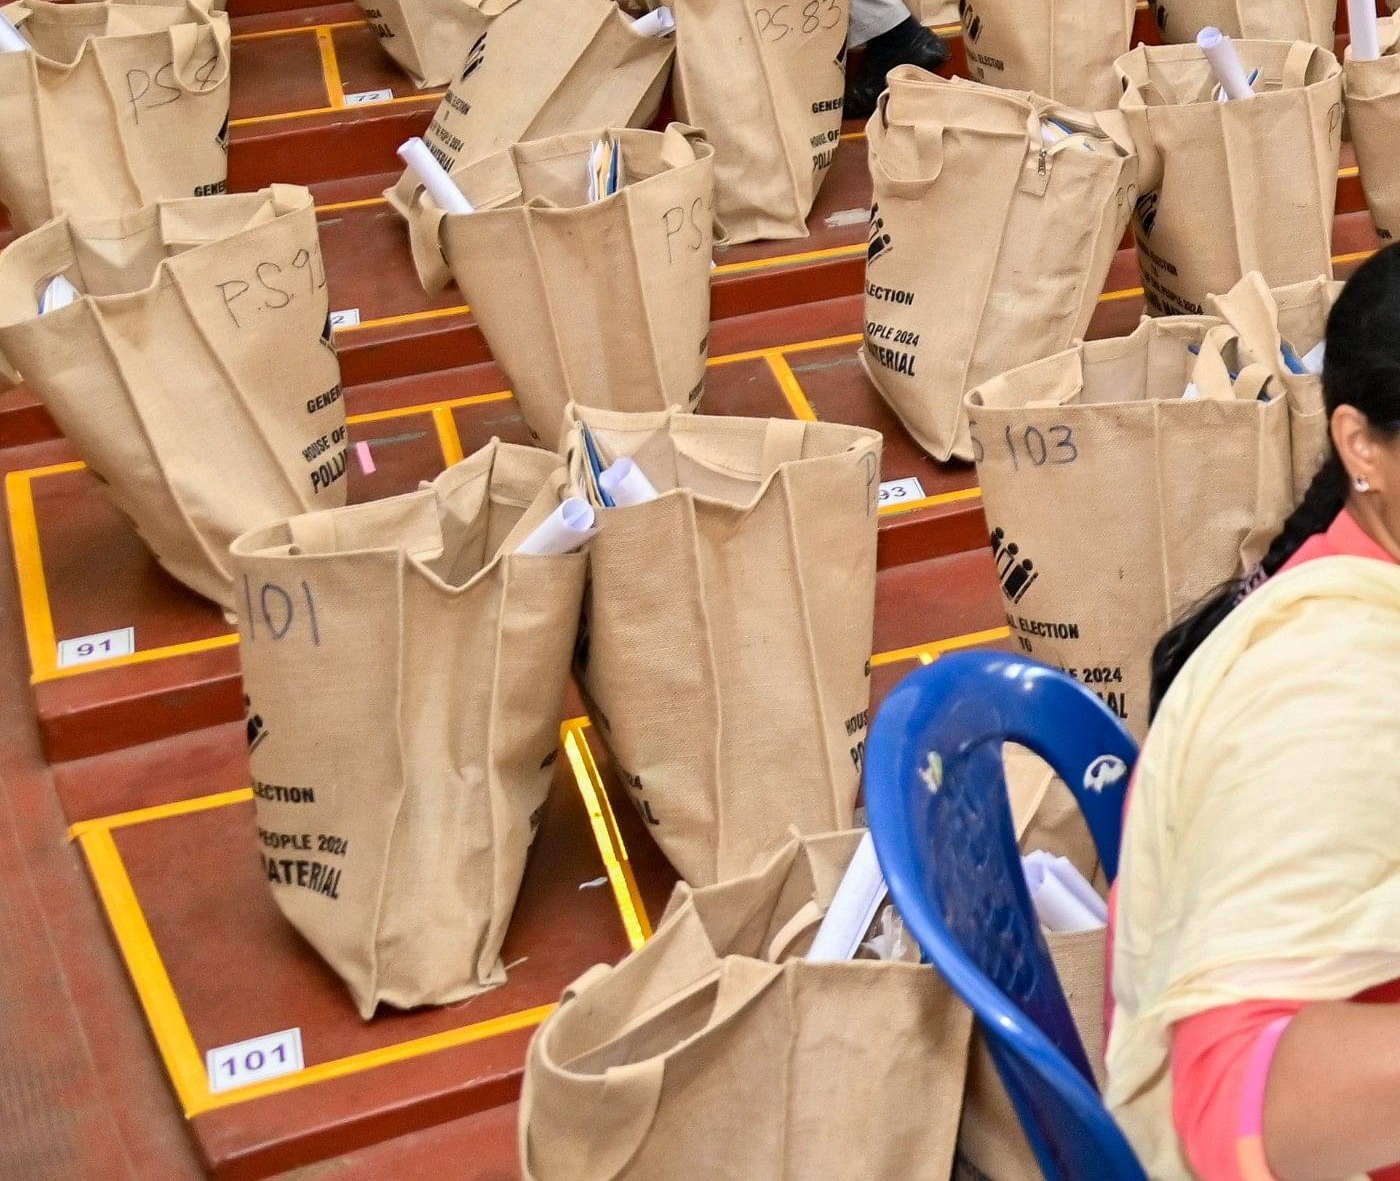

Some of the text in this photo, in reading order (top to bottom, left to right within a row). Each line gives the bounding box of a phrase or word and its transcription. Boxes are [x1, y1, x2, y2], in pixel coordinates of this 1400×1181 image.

[864, 281, 916, 306] LECTION
[331, 314, 345, 325] 2
[865, 321, 921, 348] OPLE 2024
[243, 572, 323, 648] 101
[1018, 618, 1080, 640] ELECTION
[76, 638, 114, 659] 91
[1018, 635, 1034, 653] TO
[1082, 667, 1124, 685] 2024
[253, 783, 316, 805] LECTION
[317, 833, 349, 858] 2024
[262, 857, 343, 901] ATERIAL
[220, 1043, 289, 1078] 101
